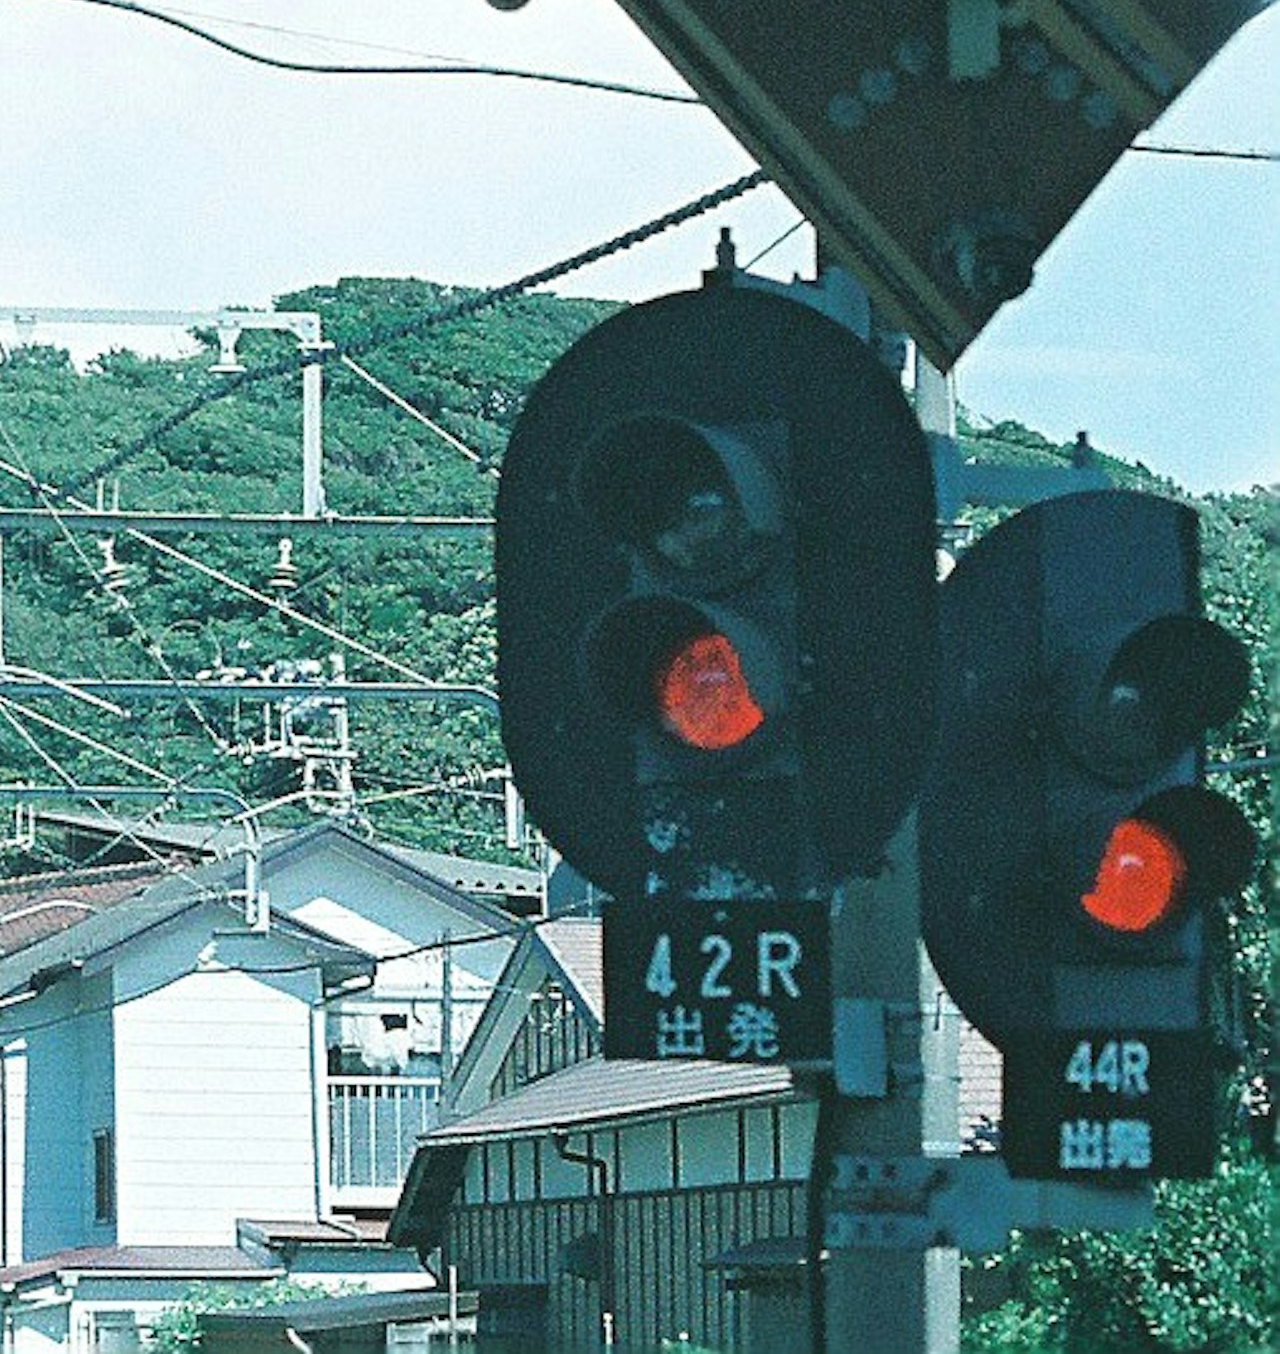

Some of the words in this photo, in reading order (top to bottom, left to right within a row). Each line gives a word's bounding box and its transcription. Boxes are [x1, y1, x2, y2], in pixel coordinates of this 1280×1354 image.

[645, 930, 804, 999] 42R
[655, 1001, 781, 1059] 出発
[1064, 1039, 1152, 1095] 44R
